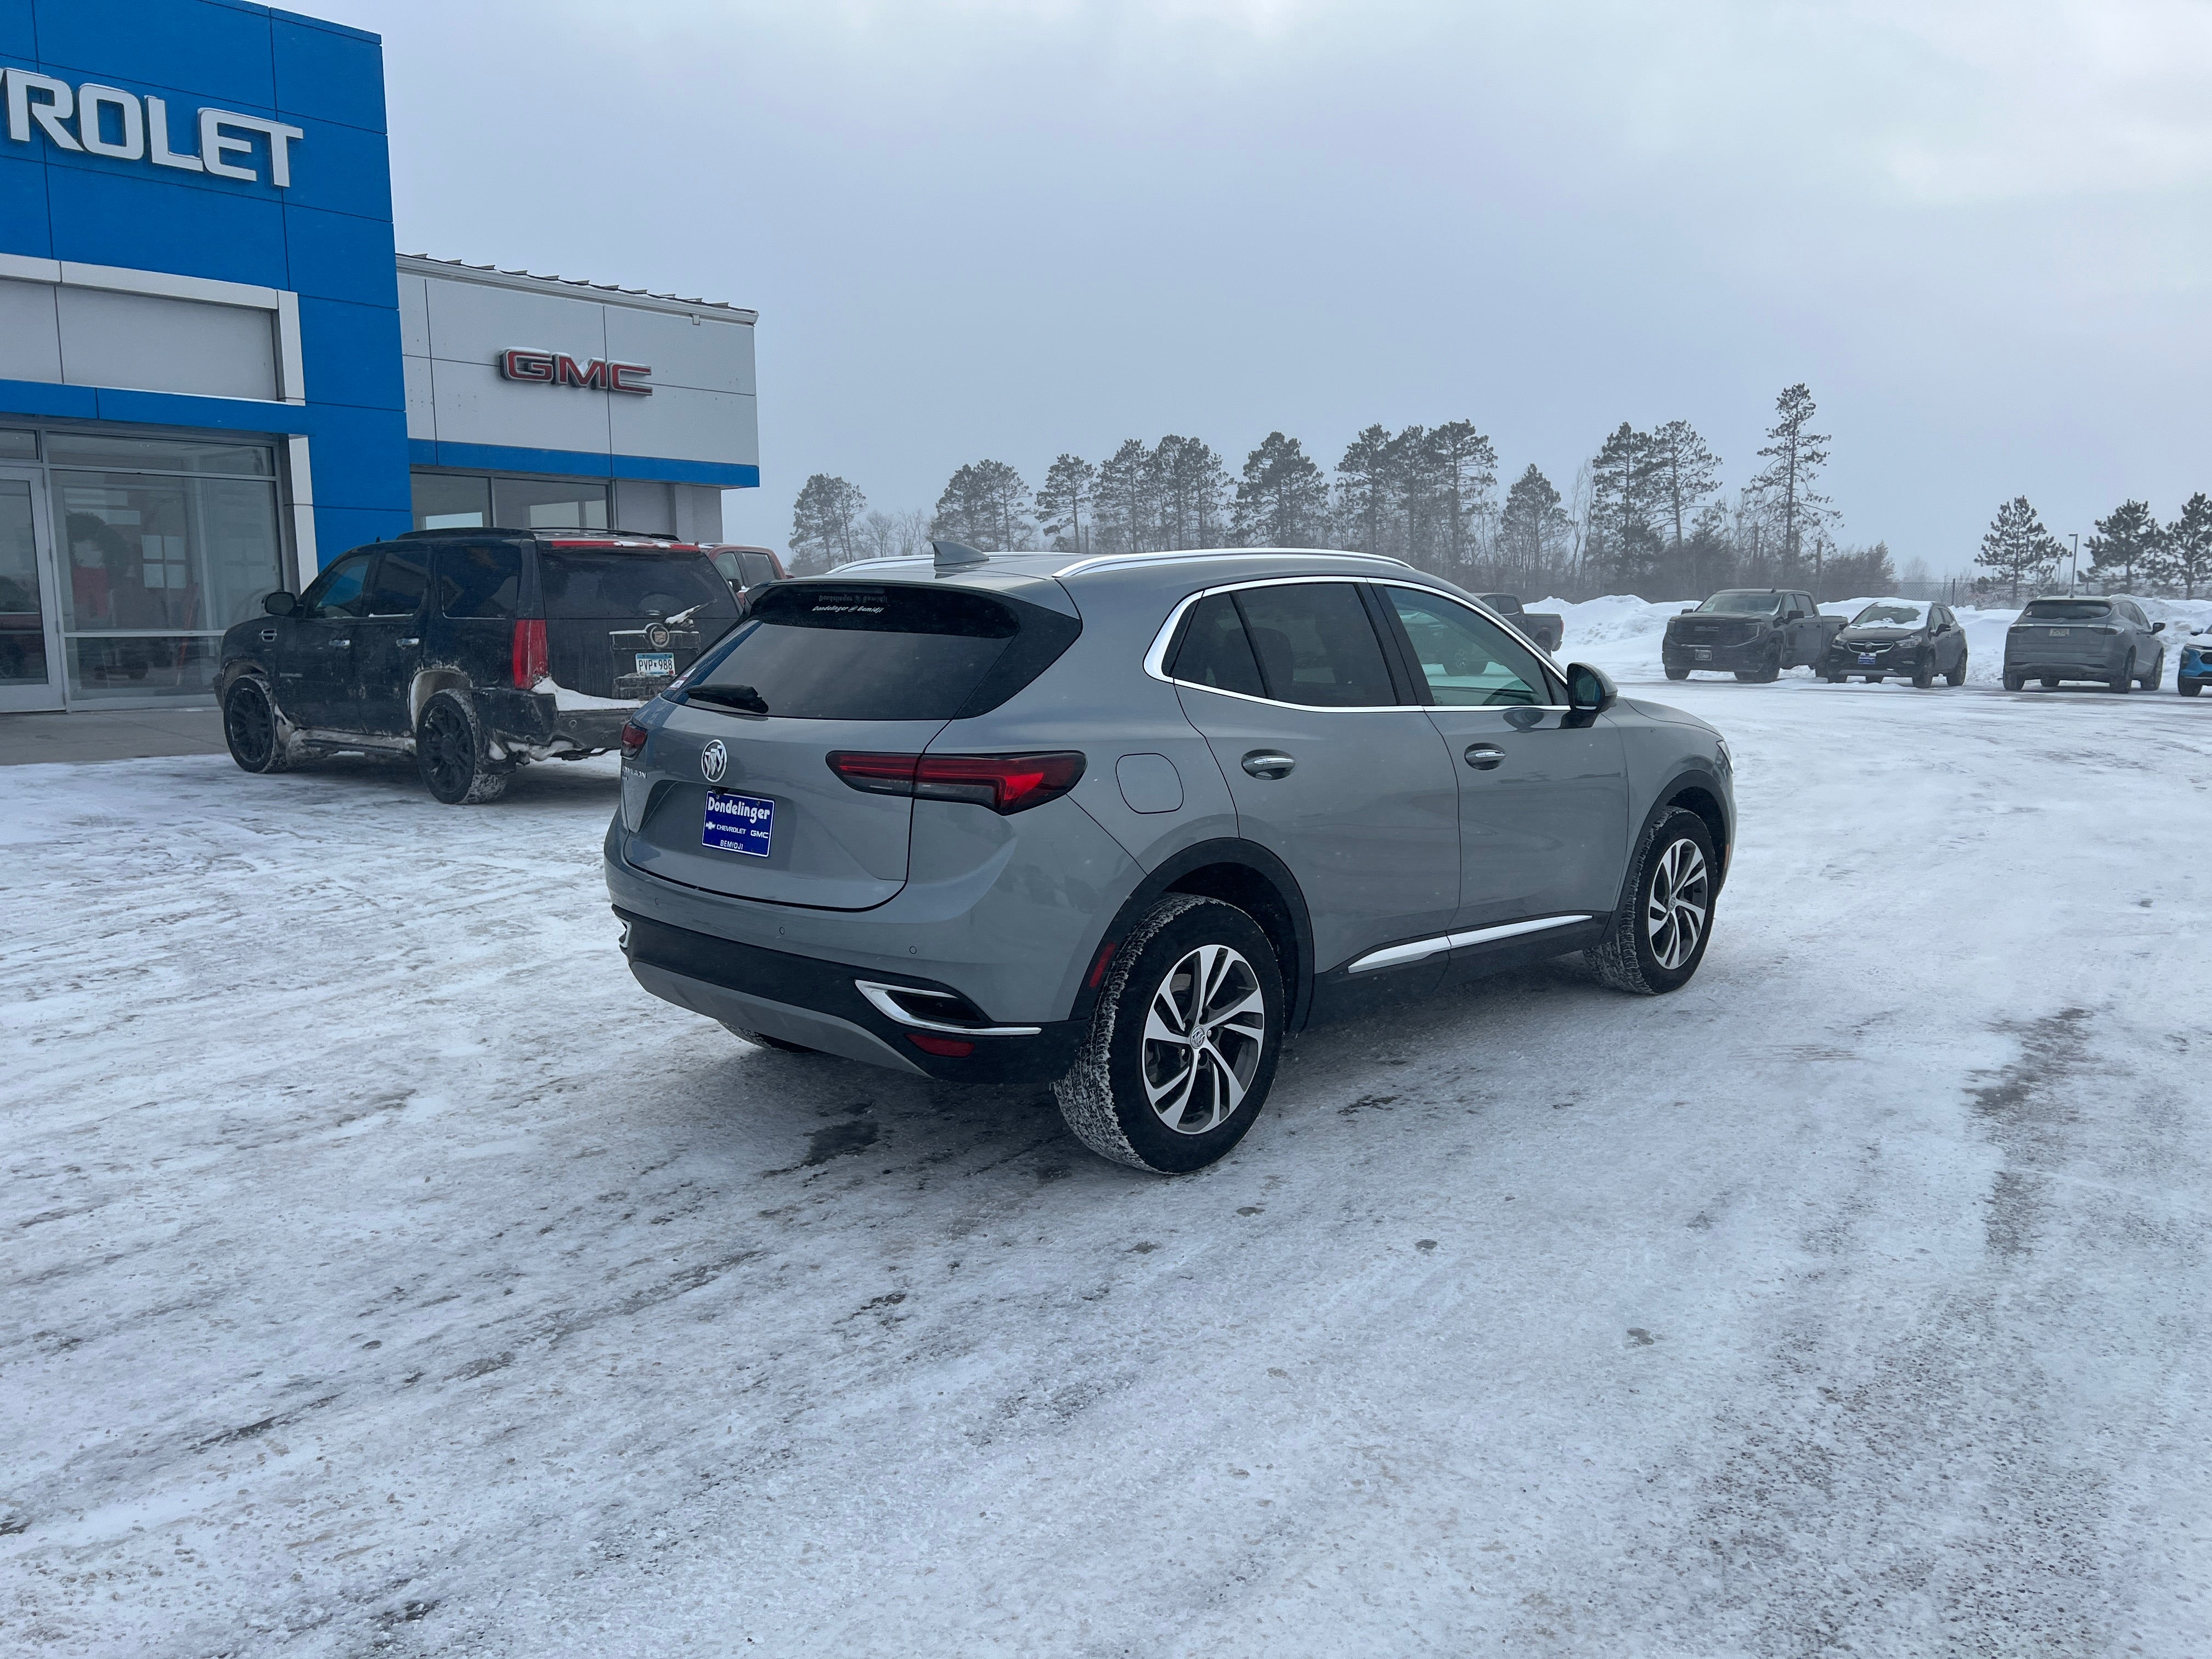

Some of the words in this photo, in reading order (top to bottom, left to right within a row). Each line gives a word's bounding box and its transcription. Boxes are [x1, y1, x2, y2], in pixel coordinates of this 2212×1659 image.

[0, 67, 303, 188] ROLET
[499, 347, 653, 396] GMC
[639, 659, 653, 670] PVP
[658, 659, 673, 670] 988
[708, 797, 770, 823] Dondelinger
[716, 824, 746, 834] CHEVROLET
[751, 830, 769, 838] GMC
[720, 840, 743, 850] BEMIDJI
